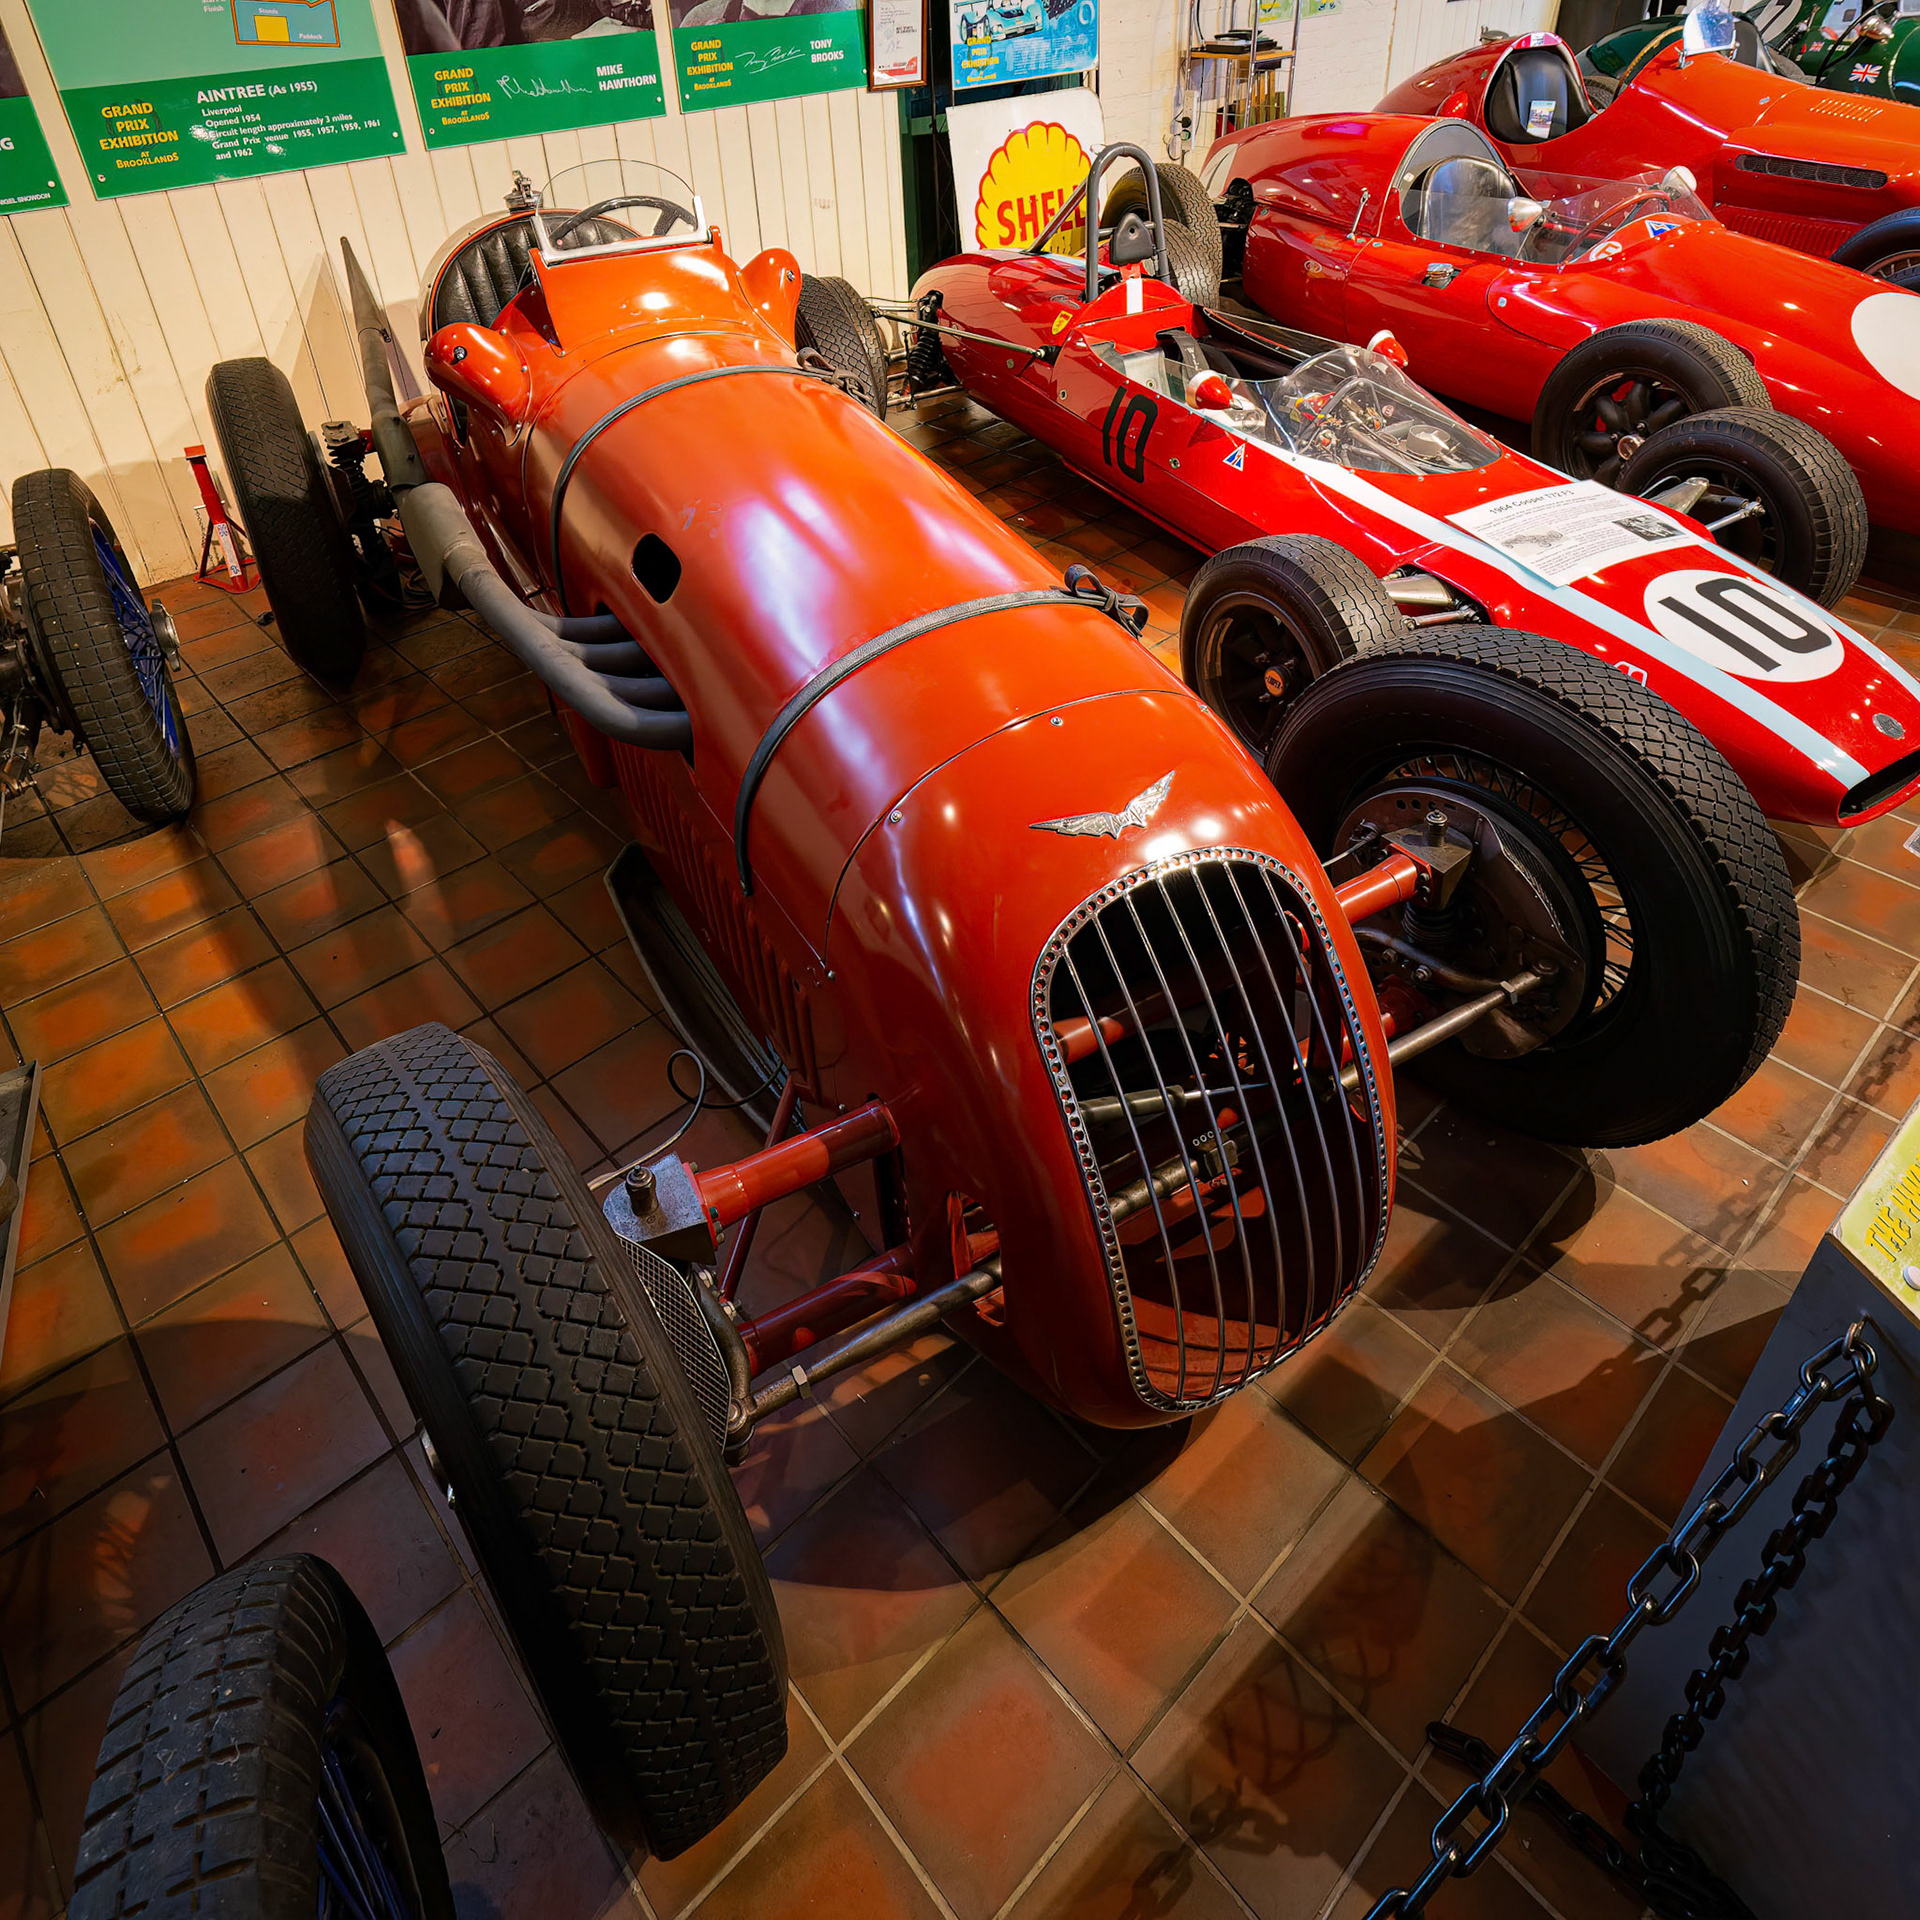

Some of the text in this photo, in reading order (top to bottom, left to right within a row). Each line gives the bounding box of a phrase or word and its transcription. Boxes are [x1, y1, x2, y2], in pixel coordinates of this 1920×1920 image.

[690, 39, 722, 51] GRAND
[809, 38, 833, 50] TONY
[698, 52, 718, 62] PRIX
[811, 50, 844, 63] BROOKS
[434, 67, 474, 81] GRAND
[596, 63, 624, 77] MIKE
[686, 62, 734, 76] EXHIBITION
[444, 81, 470, 94] PRIX
[598, 74, 657, 91] HAWTHORN
[197, 80, 318, 104] AINTREE (As 1955)
[430, 92, 491, 109] EXHIBITION
[101, 102, 154, 118] GRAND
[201, 104, 242, 117] Liverpool
[115, 118, 150, 132] PRIX
[205, 113, 261, 129] Opened 1954
[239, 124, 266, 135] length
[267, 115, 324, 132] approximately
[324, 115, 331, 123] 3
[331, 113, 353, 123] miles
[441, 111, 490, 126] BROOKLANDS
[99, 130, 179, 150] EXHIBITION
[212, 119, 381, 149] Grand Prix venue 1955, 1957, 1959, 1961
[115, 152, 179, 169] BROOKLANDS
[215, 147, 254, 160] and 1962
[997, 184, 1086, 246] SHELL
[1103, 385, 1158, 484] 10
[1489, 504, 1513, 515] 1964
[1657, 577, 1832, 673] 10
[1865, 1206, 1911, 1263] THE
